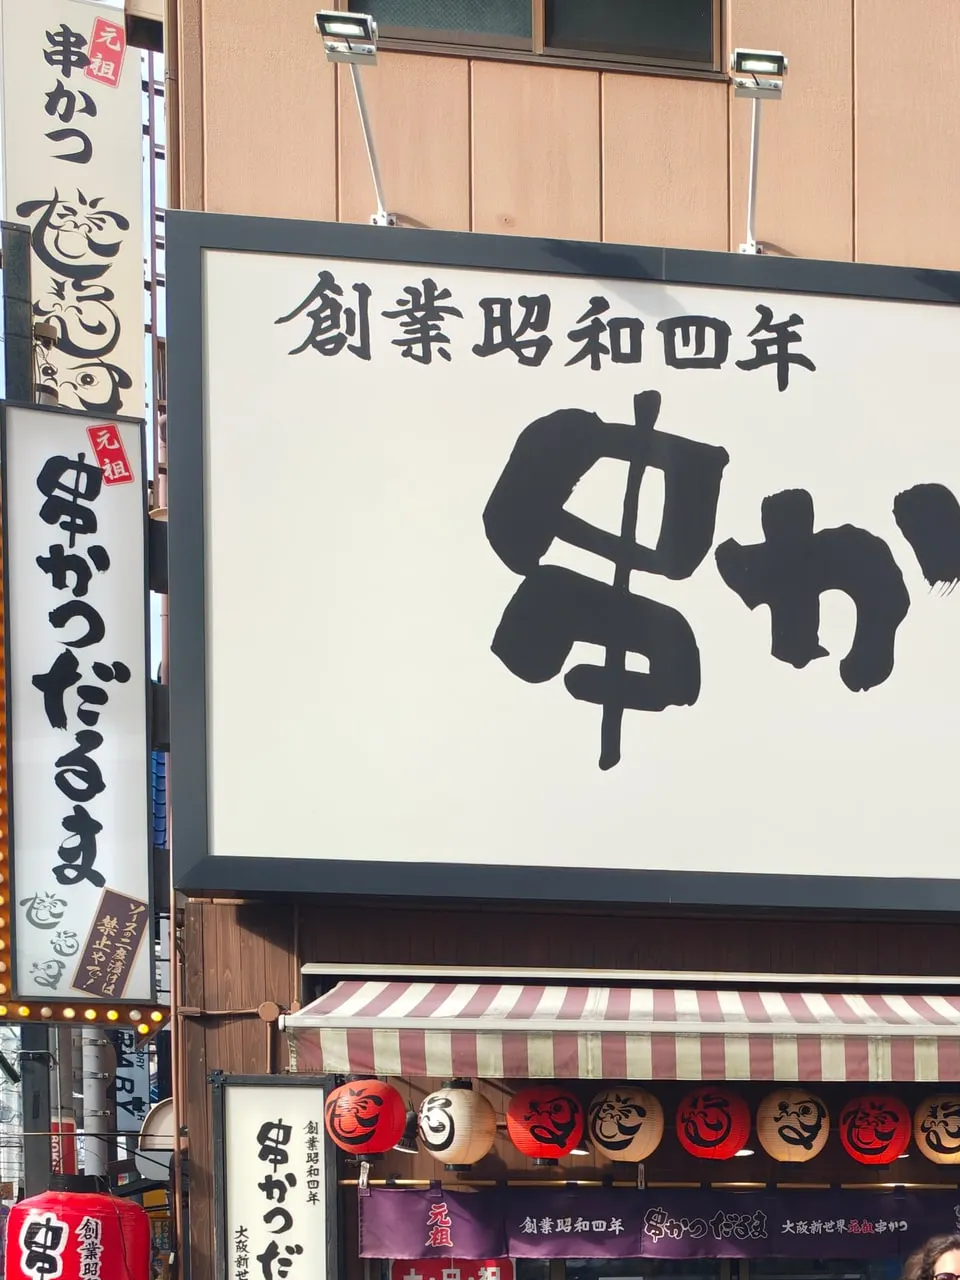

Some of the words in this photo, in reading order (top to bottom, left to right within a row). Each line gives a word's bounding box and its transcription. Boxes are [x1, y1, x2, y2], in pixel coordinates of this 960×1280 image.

[89, 25, 122, 81] 元祖
[42, 23, 97, 164] 串かつ
[275, 271, 816, 391] 創業昭和四年
[95, 428, 129, 485] 元祖
[32, 452, 131, 888] 串かつだるま
[304, 1120, 320, 1206] 創業昭和四年
[425, 1202, 453, 1247] 元祖
[519, 1216, 625, 1235] 創業昭和四年
[644, 1207, 768, 1243] 串かつだるま
[781, 1220, 908, 1235] 大阪新世界元祖串かつ
